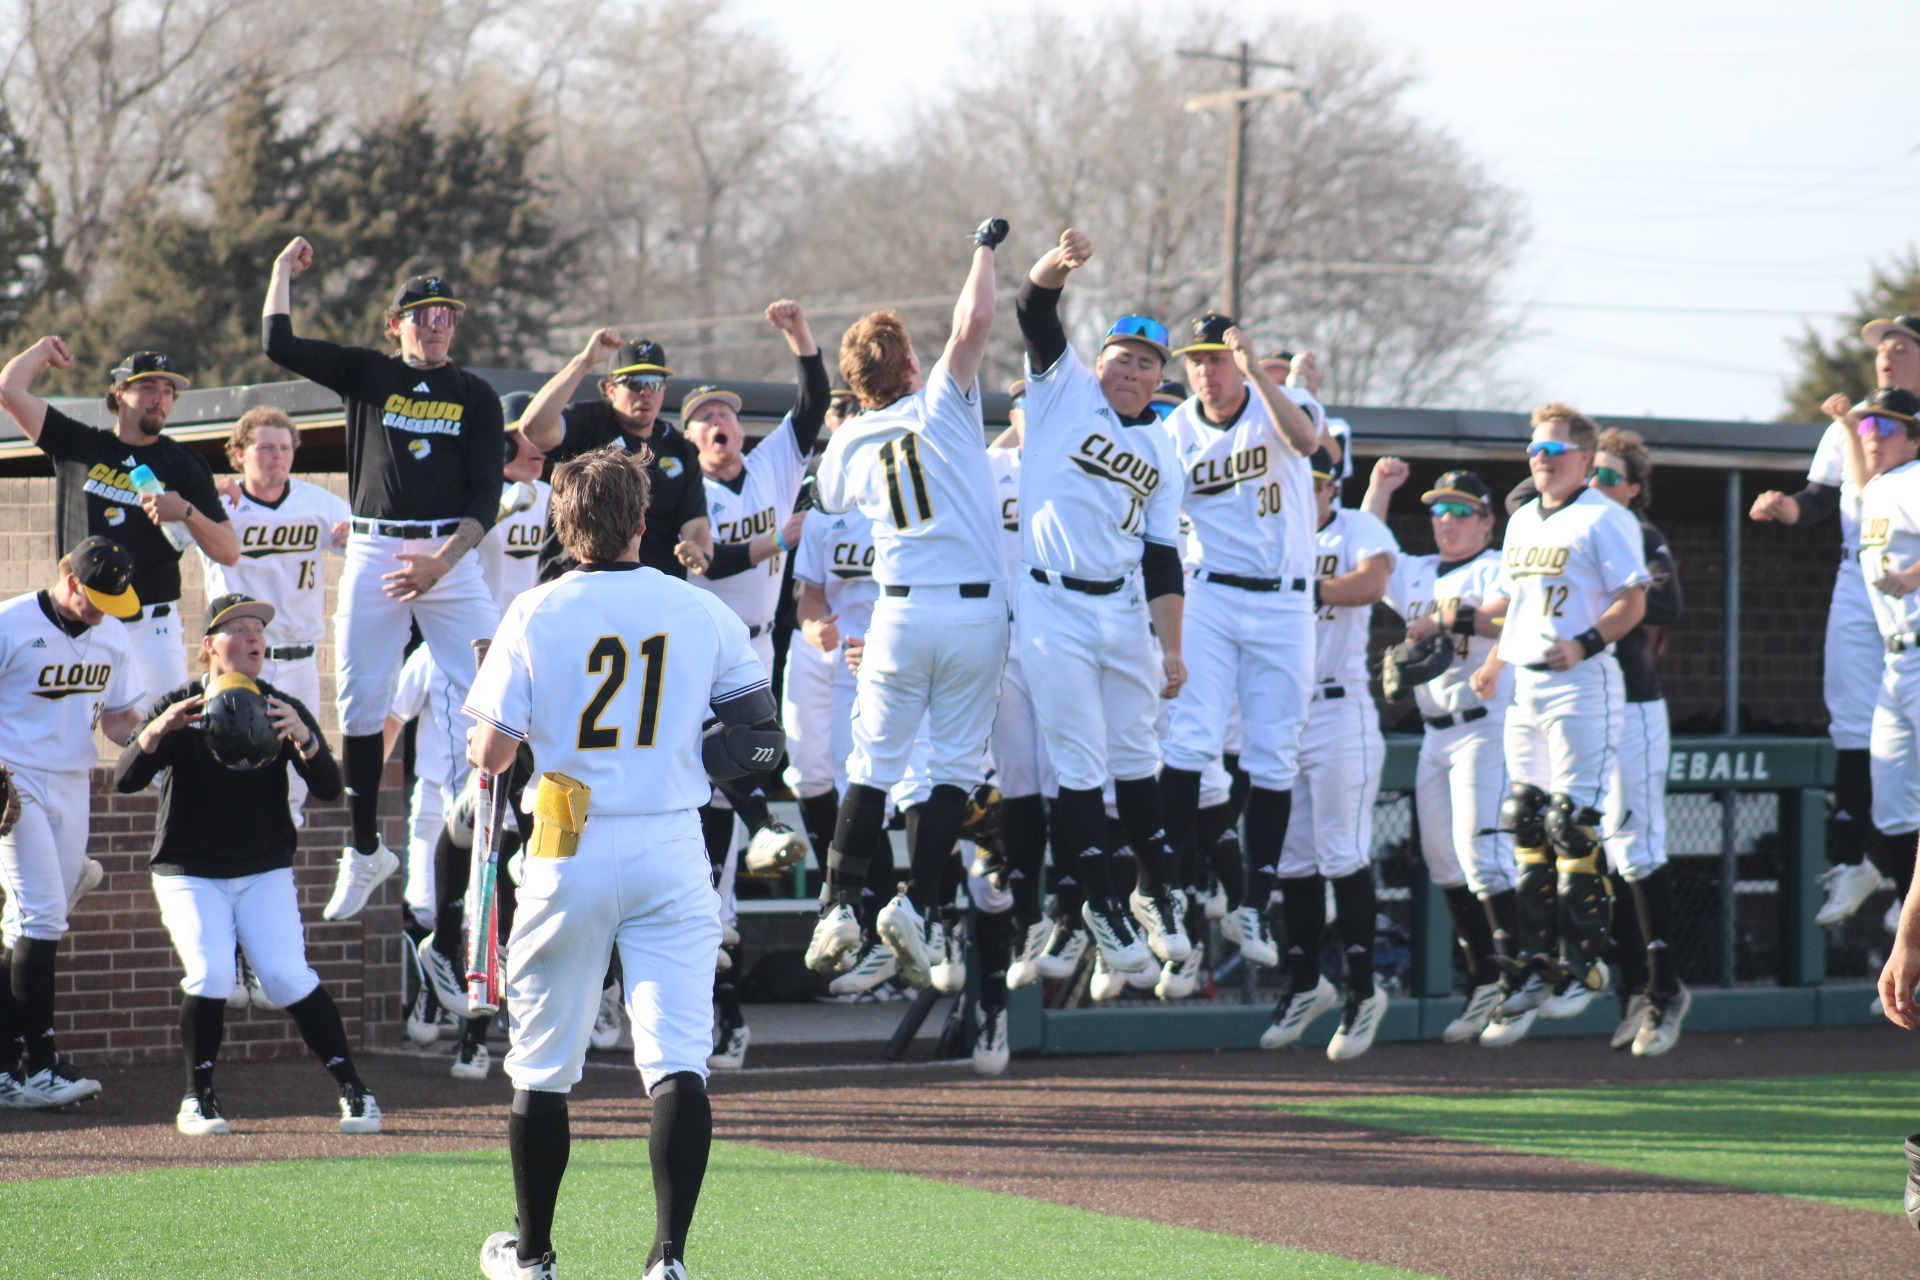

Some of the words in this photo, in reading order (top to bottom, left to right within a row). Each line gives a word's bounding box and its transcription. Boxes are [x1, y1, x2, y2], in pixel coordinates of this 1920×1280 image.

[384, 393, 464, 421] CLOUD
[382, 412, 461, 436] BASEBALL
[1080, 432, 1159, 491] CLOUD
[1192, 445, 1267, 485] CLOUD
[87, 463, 166, 492] CLO
[878, 431, 935, 532] 11
[82, 478, 145, 507] BASEBA
[1257, 482, 1281, 518] 30
[243, 524, 319, 546] CLOUD
[507, 524, 545, 546] CLO
[718, 506, 776, 544] CLOUD
[833, 542, 876, 567] CLO
[1507, 546, 1570, 568] CLOUD
[297, 559, 316, 590] 15
[1543, 584, 1569, 617] 12
[38, 663, 112, 687] CLOUD
[576, 632, 668, 751] 21
[1669, 751, 1770, 781] EBALL
